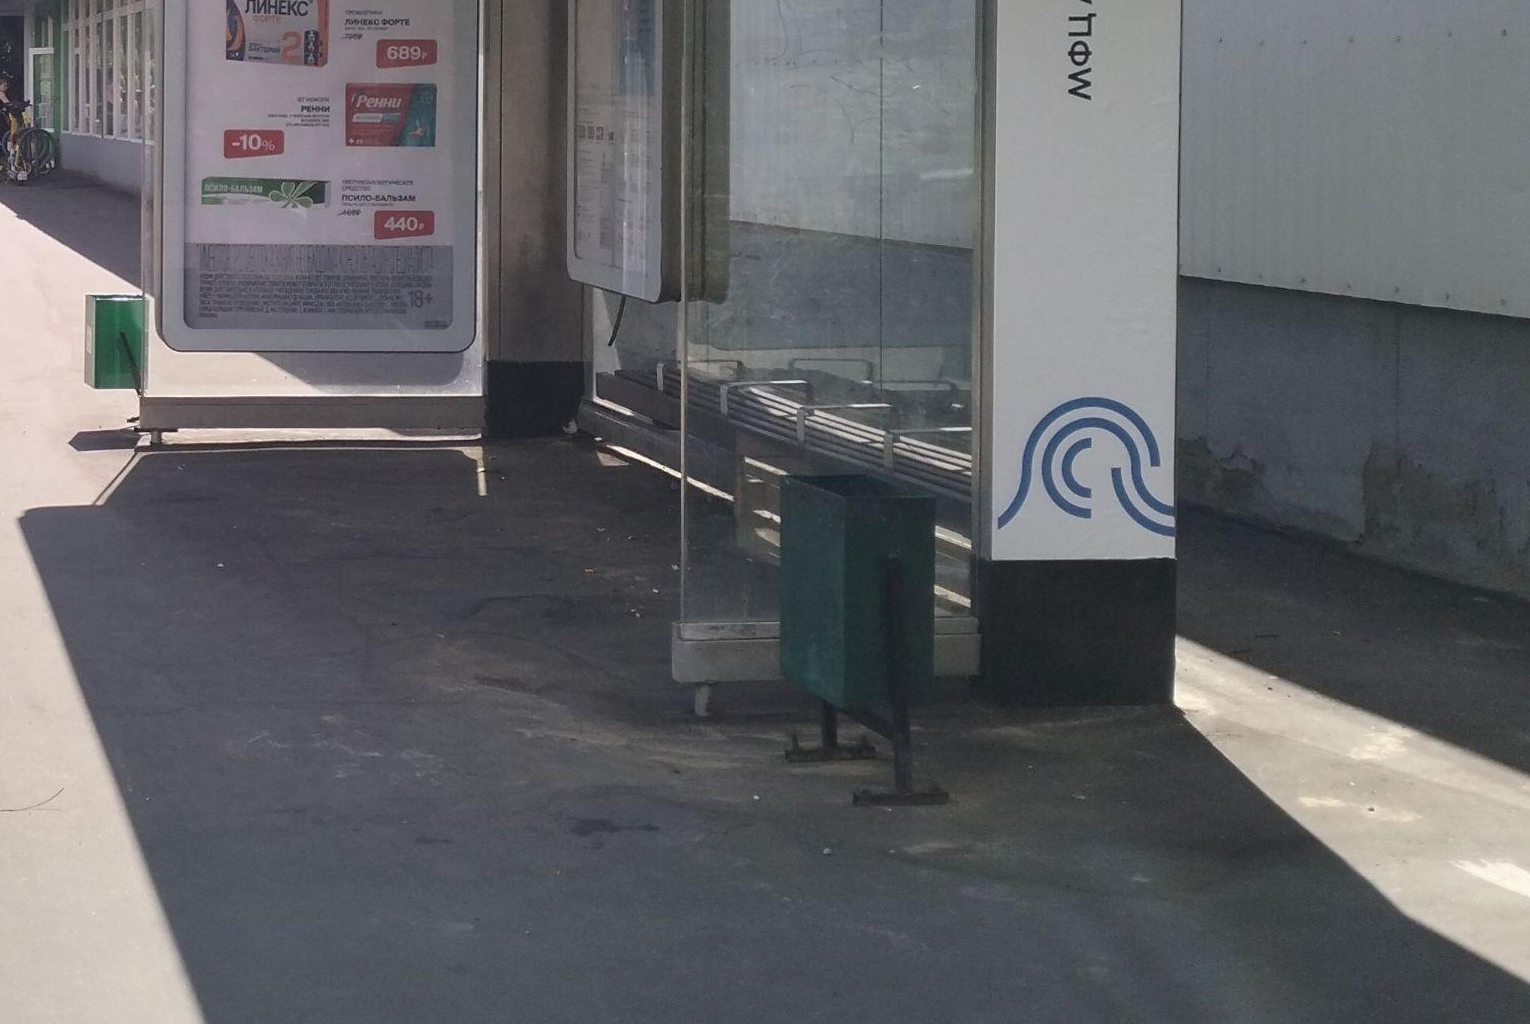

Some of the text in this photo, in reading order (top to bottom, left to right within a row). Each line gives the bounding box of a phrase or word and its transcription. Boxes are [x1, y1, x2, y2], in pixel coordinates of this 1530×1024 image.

[344, 18, 411, 26] ЛИНЕКС ФОРТЕ
[1068, 13, 1097, 100] МФЦ
[356, 94, 402, 108] Ренни
[300, 105, 330, 113] РЕННИ
[408, 289, 434, 308] 18+
